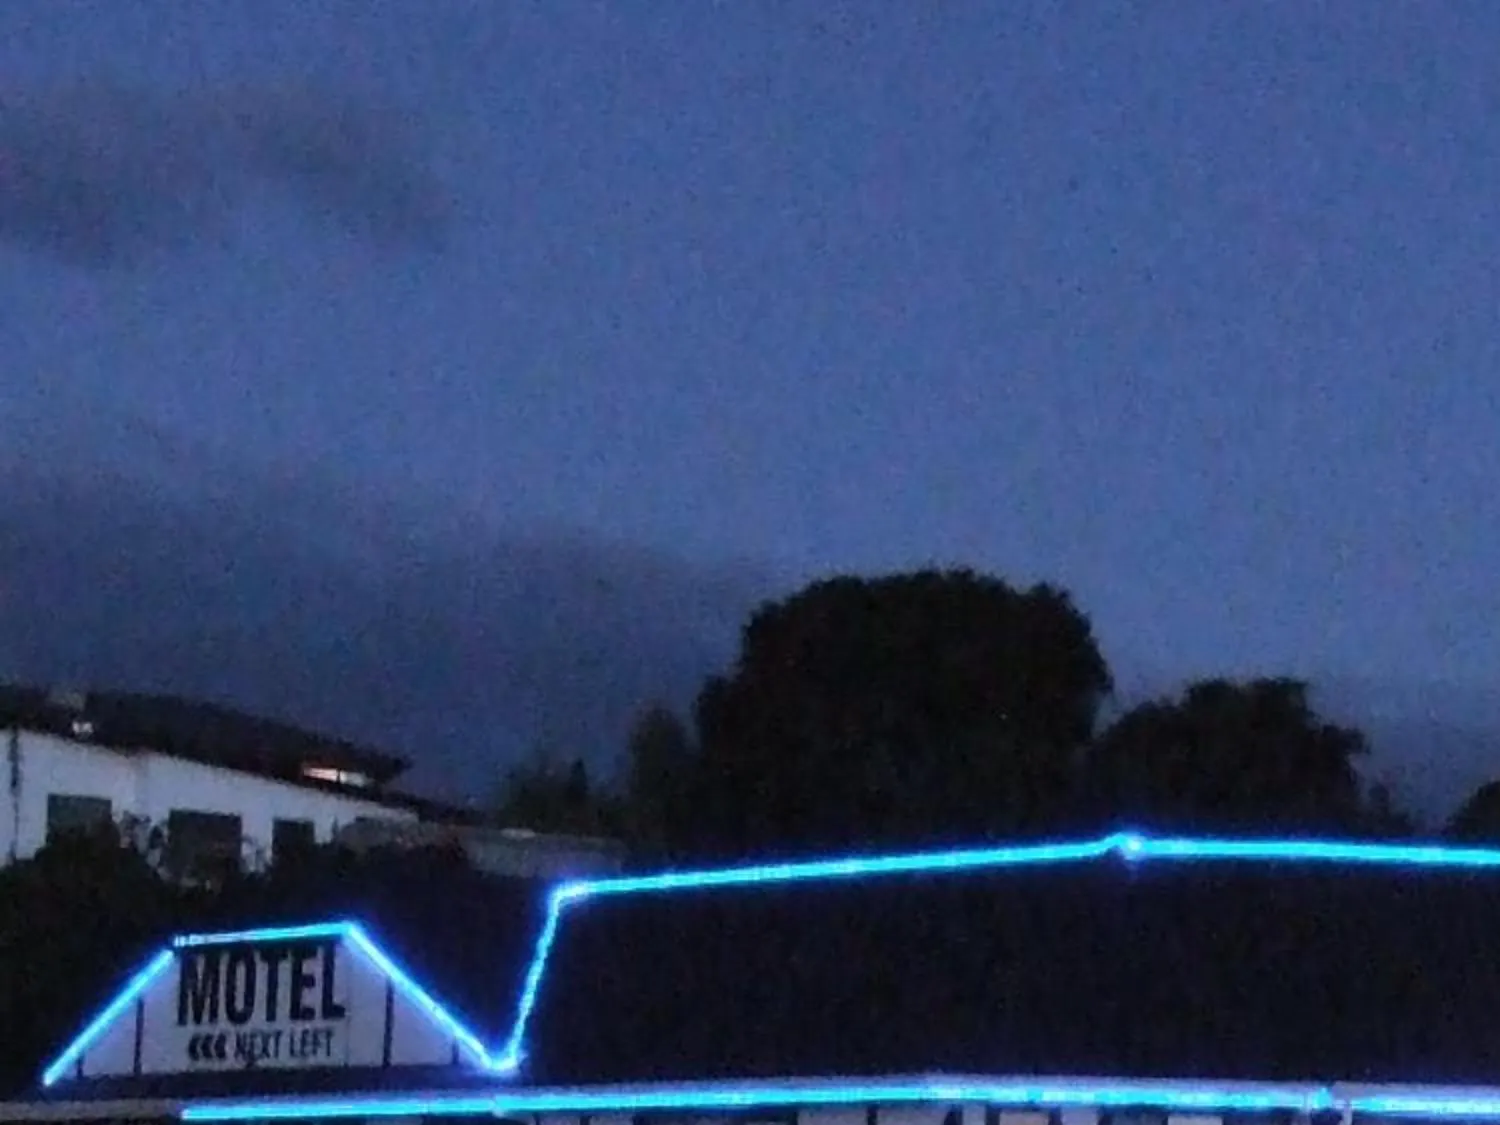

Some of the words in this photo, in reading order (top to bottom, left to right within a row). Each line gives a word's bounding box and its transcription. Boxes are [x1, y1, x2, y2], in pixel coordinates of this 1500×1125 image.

[178, 943, 345, 1026] MOTEL
[234, 1029, 282, 1062] NEXT
[288, 1028, 333, 1057] LEFT
